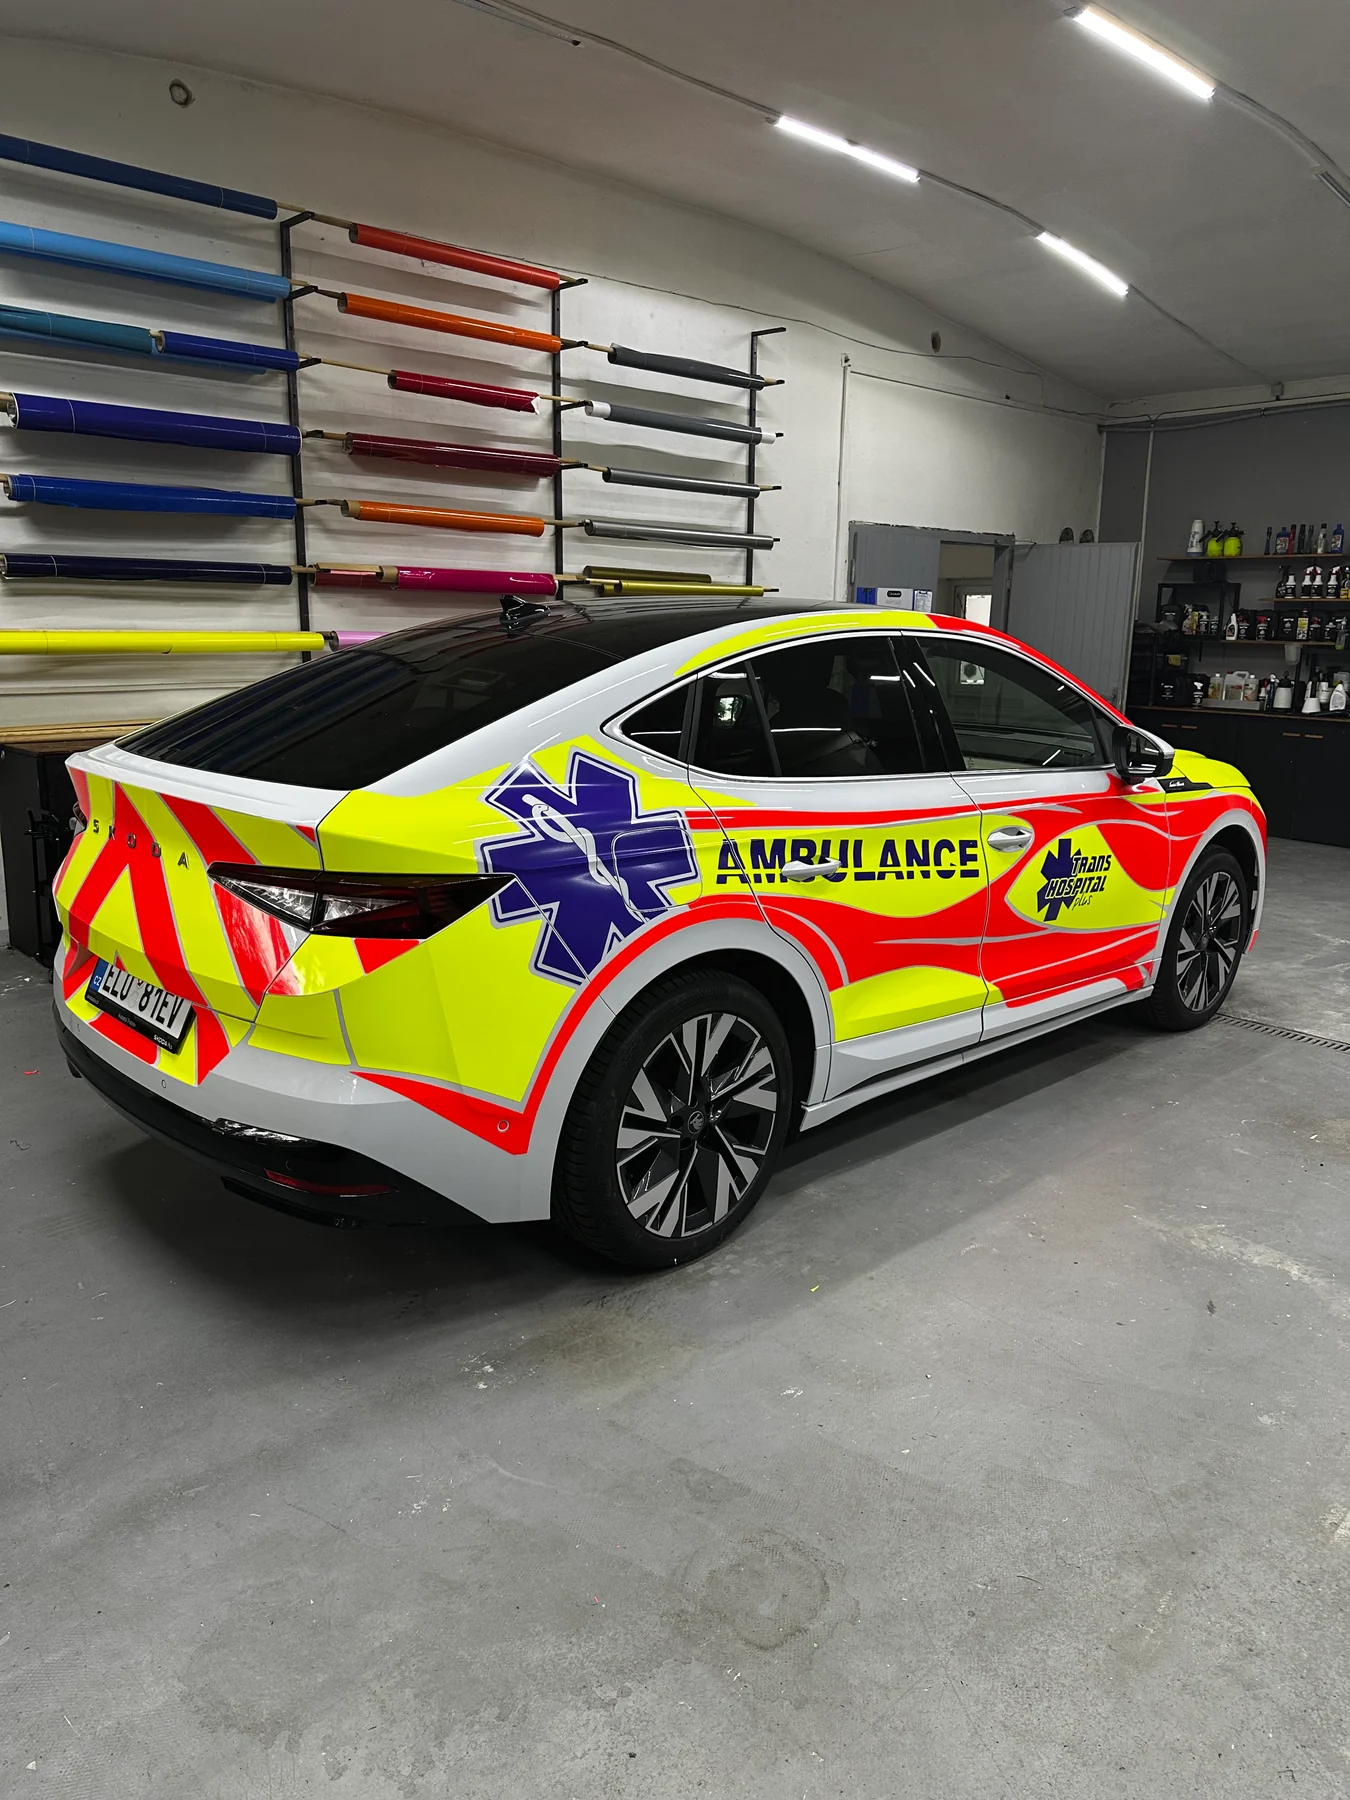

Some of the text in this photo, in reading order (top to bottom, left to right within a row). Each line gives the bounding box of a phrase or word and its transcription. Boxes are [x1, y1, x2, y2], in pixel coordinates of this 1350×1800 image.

[716, 839, 979, 885] AMBULANCE
[1072, 892, 1093, 911] plus
[93, 975, 102, 987] CZ
